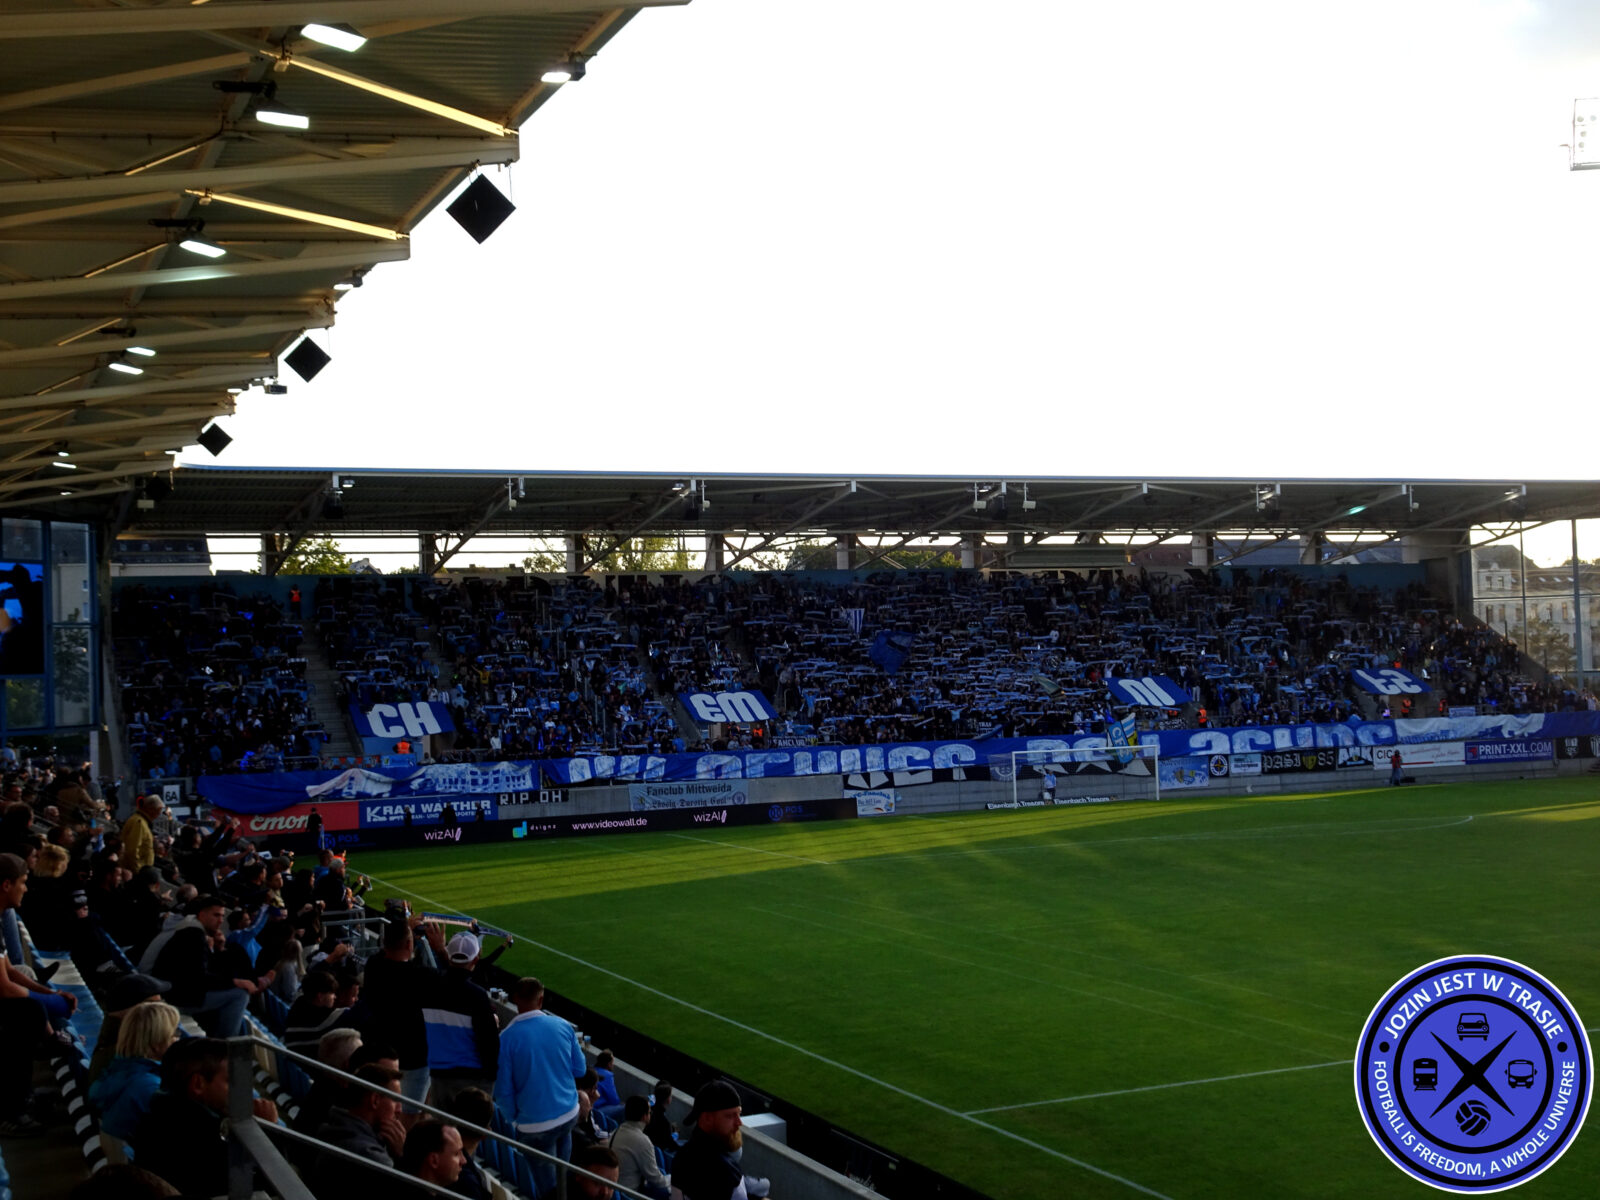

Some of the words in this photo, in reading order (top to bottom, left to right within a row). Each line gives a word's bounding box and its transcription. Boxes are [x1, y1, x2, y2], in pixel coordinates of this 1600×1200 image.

[367, 701, 442, 738] CH
[1479, 742, 1551, 755] PRINT-XXL.COM
[646, 785, 684, 796] Fanclub
[686, 783, 732, 794] Mittweida
[166, 791, 178, 802] 6A
[571, 818, 649, 831] www.videowall.de
[424, 829, 455, 842] wizAI
